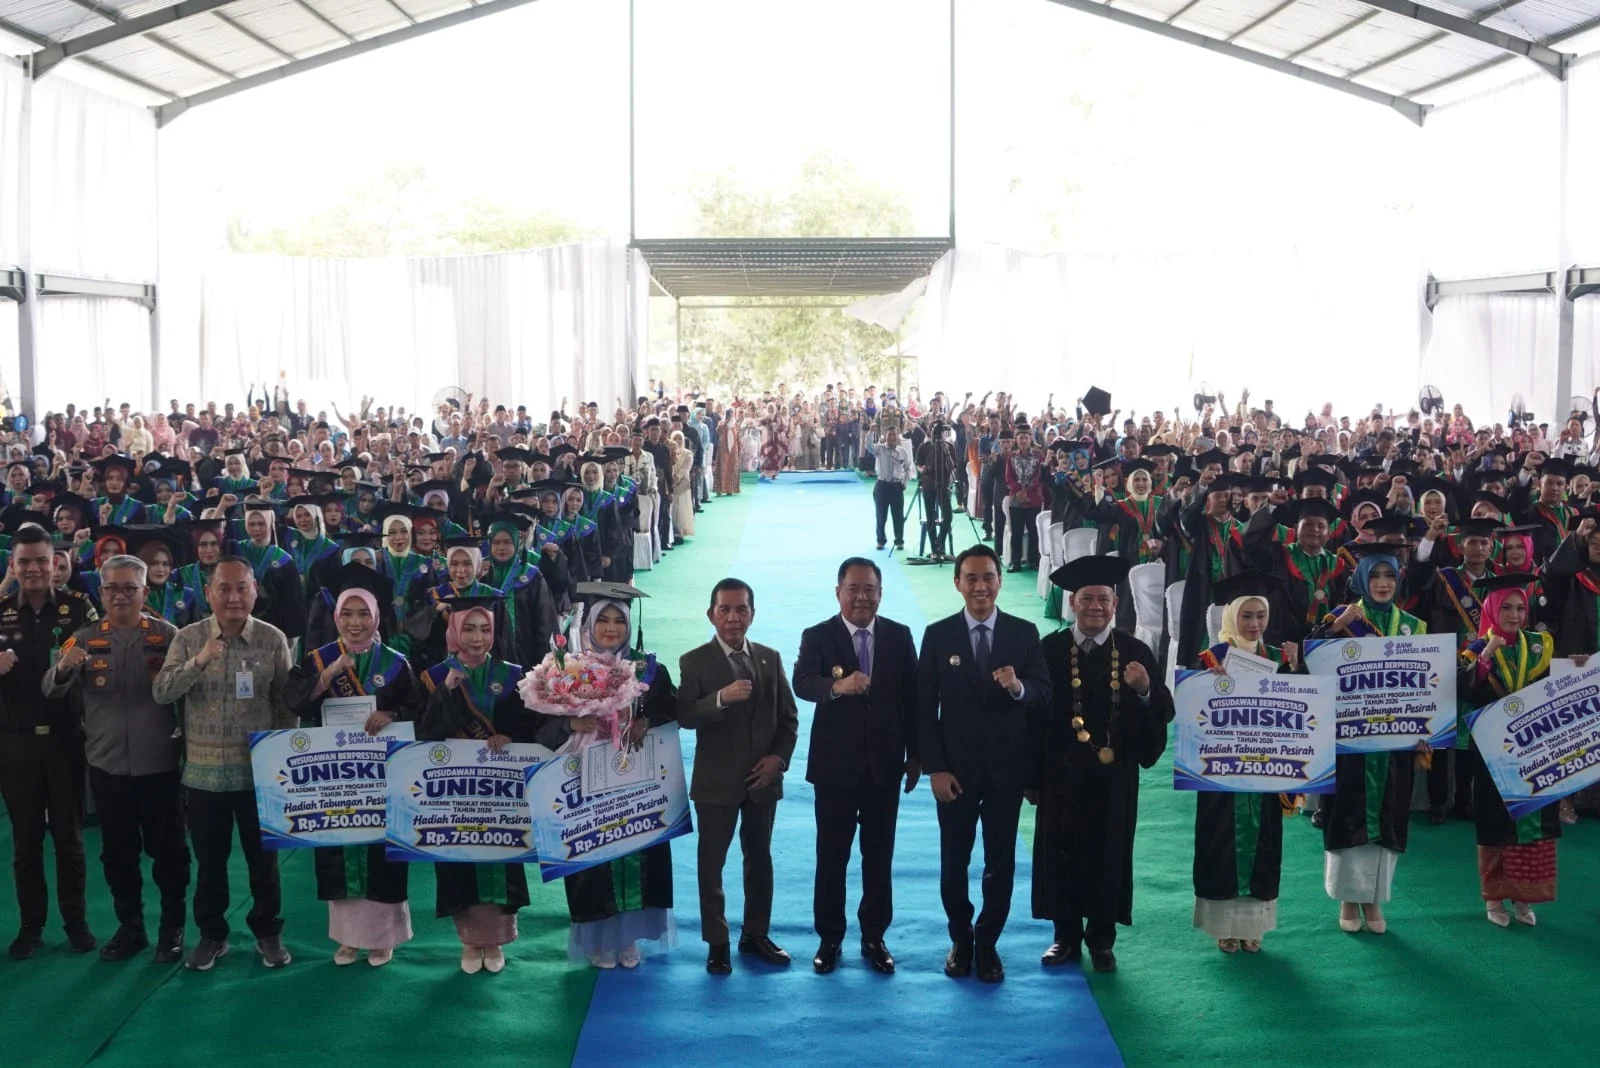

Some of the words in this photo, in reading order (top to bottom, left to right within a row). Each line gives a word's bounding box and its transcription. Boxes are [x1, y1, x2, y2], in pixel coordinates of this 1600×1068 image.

[1340, 663, 1383, 674] WISUDAWAN
[1385, 661, 1427, 670] BERPRESTASI
[1340, 671, 1425, 692] UNISKI
[1211, 699, 1257, 707] WISUDAWAN
[1259, 699, 1304, 711] BERPRESTASI
[1336, 706, 1360, 718] adiah
[1362, 706, 1402, 716] Tabungan
[1405, 702, 1436, 714] Pesirah
[1509, 704, 1552, 732] WISUDAWAN
[1552, 687, 1596, 710] BERPRESTASI
[1212, 709, 1302, 730] UNISKI
[1199, 744, 1232, 754] Hadiah
[1234, 744, 1277, 755] Tabungan
[1280, 745, 1314, 755] Pesirah
[289, 753, 336, 766] WISUDAWAN
[338, 752, 386, 760] BERPRESTASI
[1519, 757, 1549, 778] Hadiah
[1549, 738, 1590, 761] Tabungan
[292, 762, 386, 785] UNISKI
[426, 768, 475, 779] WISUDAWAN
[426, 778, 524, 799] UNISKI
[284, 800, 317, 813] Hadiah
[318, 798, 363, 808] Tabungan
[563, 807, 591, 820] AKADEMIK
[592, 800, 616, 810] TINGKAT
[617, 790, 644, 802] PROGRAM
[645, 784, 660, 793] STUDI
[561, 820, 592, 840] Hadiah
[593, 809, 634, 827] Tabungan
[637, 794, 668, 812] Pesirah
[594, 807, 615, 815] TAHUN
[413, 815, 448, 825] Hadiah
[450, 815, 496, 825] Tabungan
